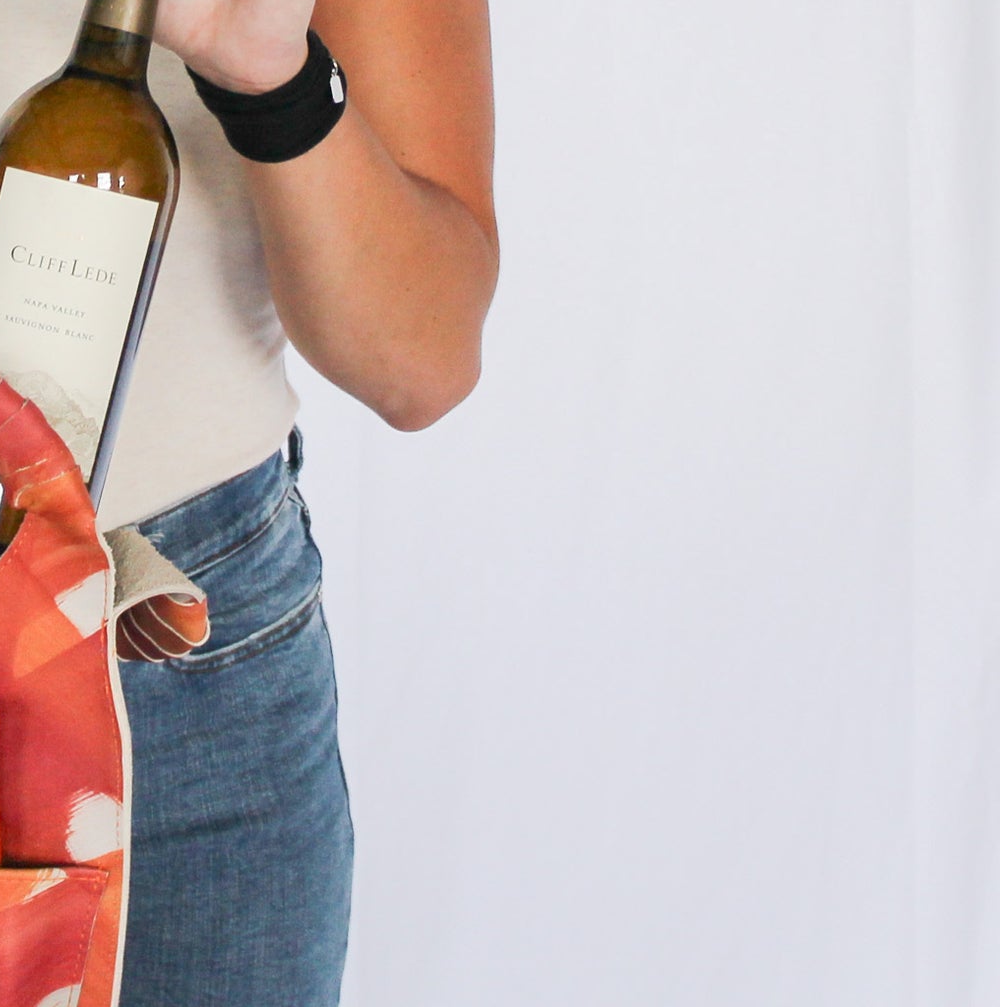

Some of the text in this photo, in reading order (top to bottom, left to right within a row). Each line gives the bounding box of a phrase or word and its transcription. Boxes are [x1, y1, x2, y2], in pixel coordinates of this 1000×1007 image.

[24, 297, 87, 319] NAPA VALLEY
[4, 314, 95, 342] SAUVIGNON BLANC
